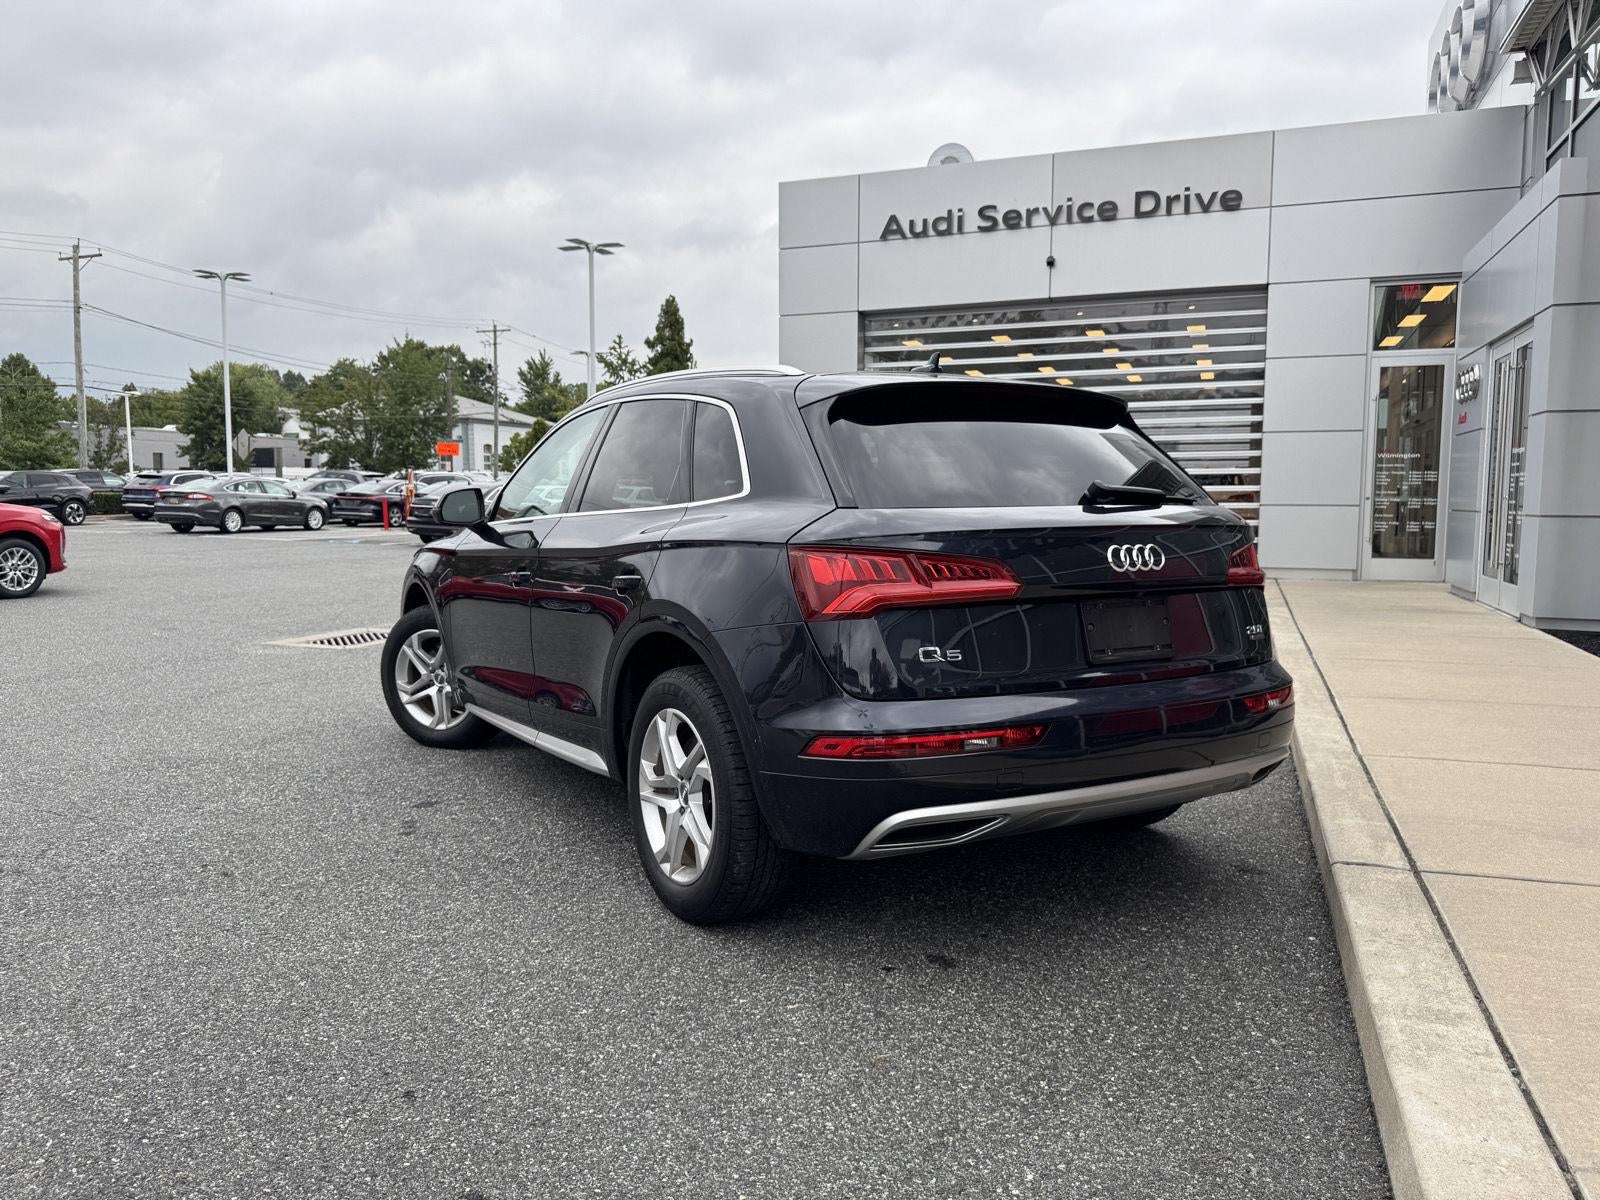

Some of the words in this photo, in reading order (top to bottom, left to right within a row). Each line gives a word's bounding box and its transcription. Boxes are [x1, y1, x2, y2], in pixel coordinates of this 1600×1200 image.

[880, 208, 965, 241] Audi
[976, 197, 1119, 232] Service
[1134, 187, 1244, 218] Drive
[918, 646, 962, 663] Q5
